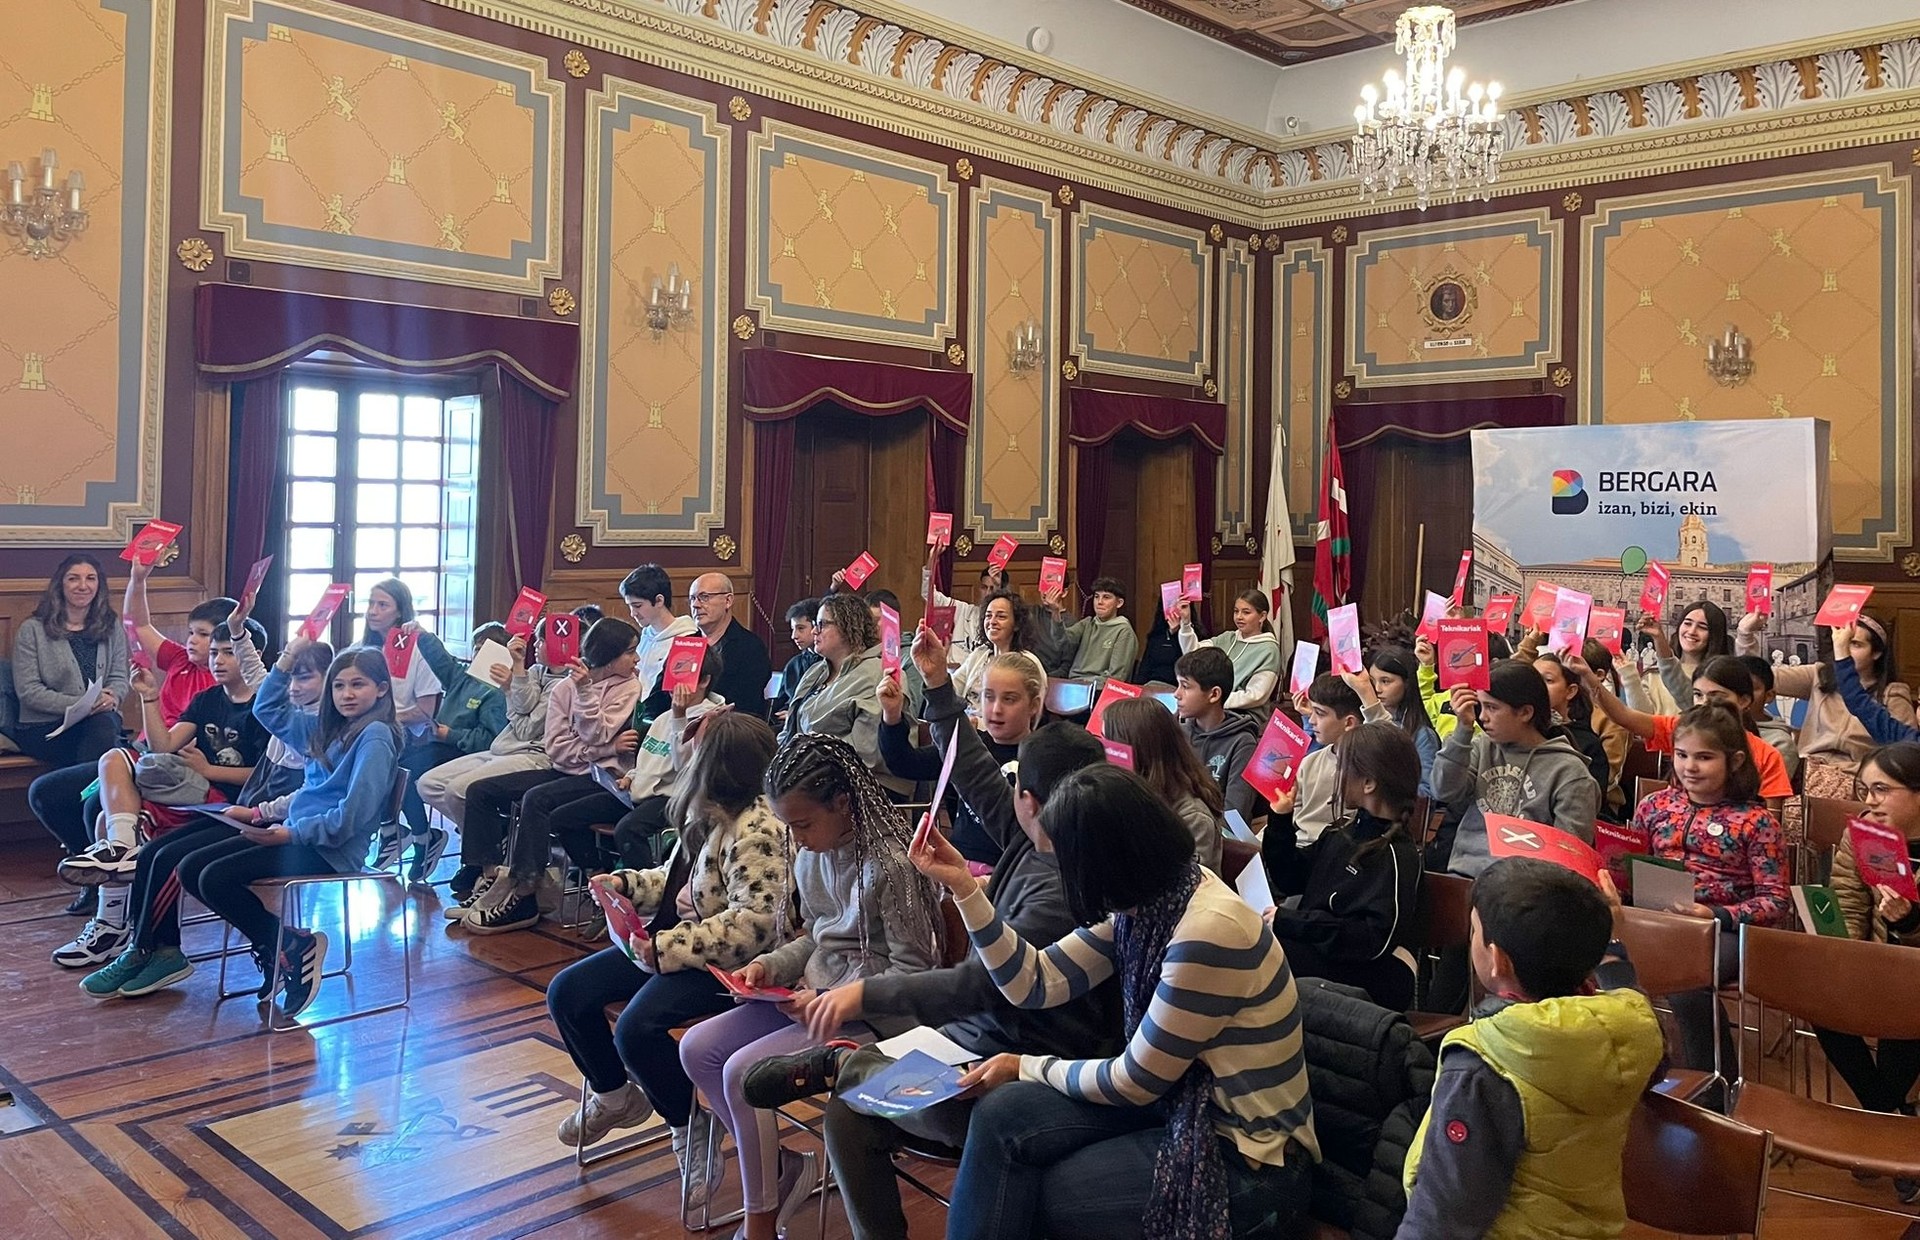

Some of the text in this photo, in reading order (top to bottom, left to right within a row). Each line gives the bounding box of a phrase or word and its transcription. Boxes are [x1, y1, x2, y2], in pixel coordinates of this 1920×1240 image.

[1600, 471, 1717, 492] BERGARA
[1599, 502, 1717, 517] izan, bizi, ekin
